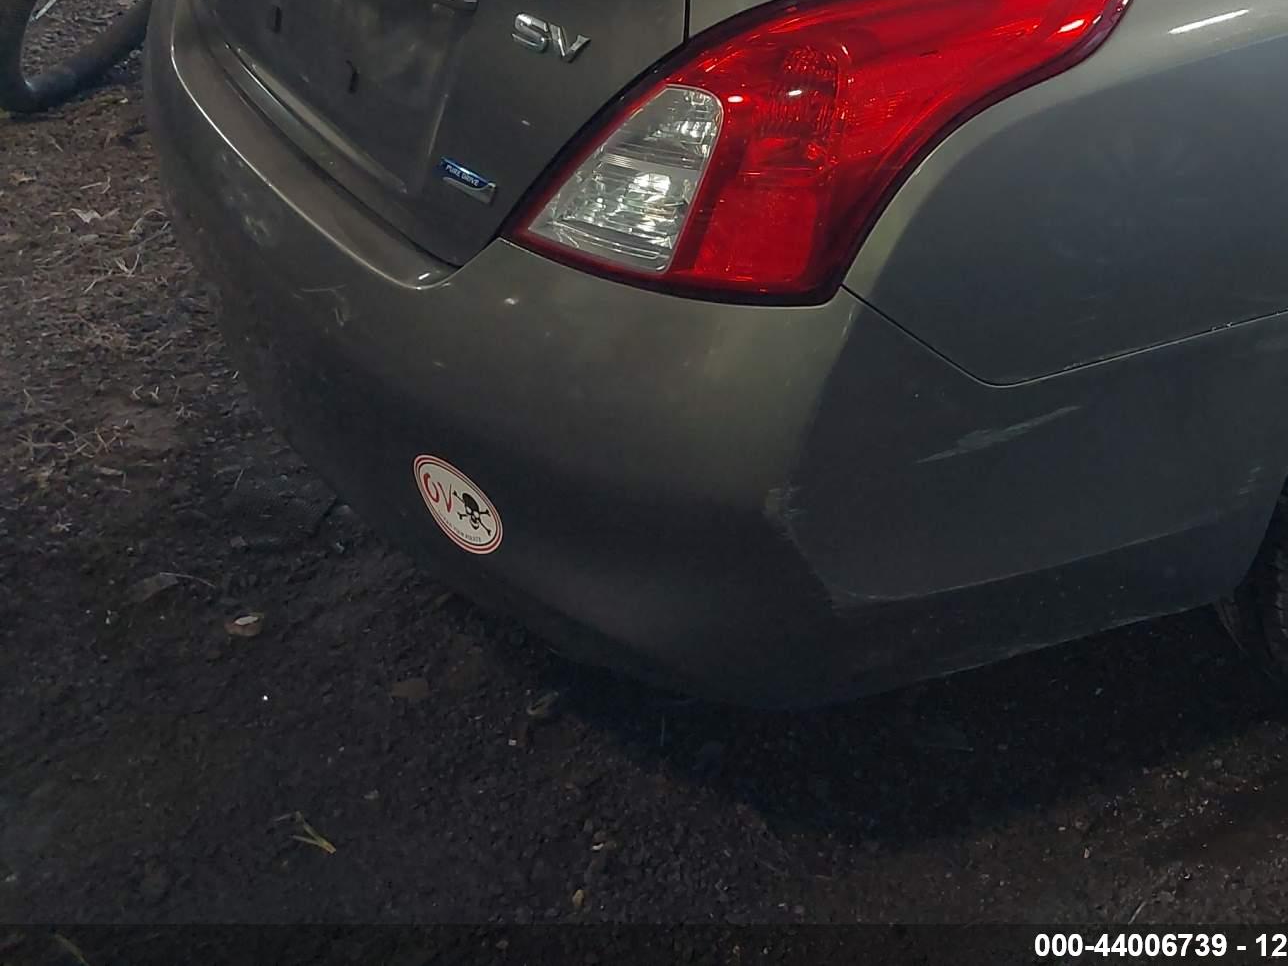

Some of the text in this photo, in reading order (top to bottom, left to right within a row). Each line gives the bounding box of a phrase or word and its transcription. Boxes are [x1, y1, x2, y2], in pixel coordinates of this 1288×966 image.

[511, 13, 591, 63] SV
[445, 164, 480, 186] PURE DRIVE
